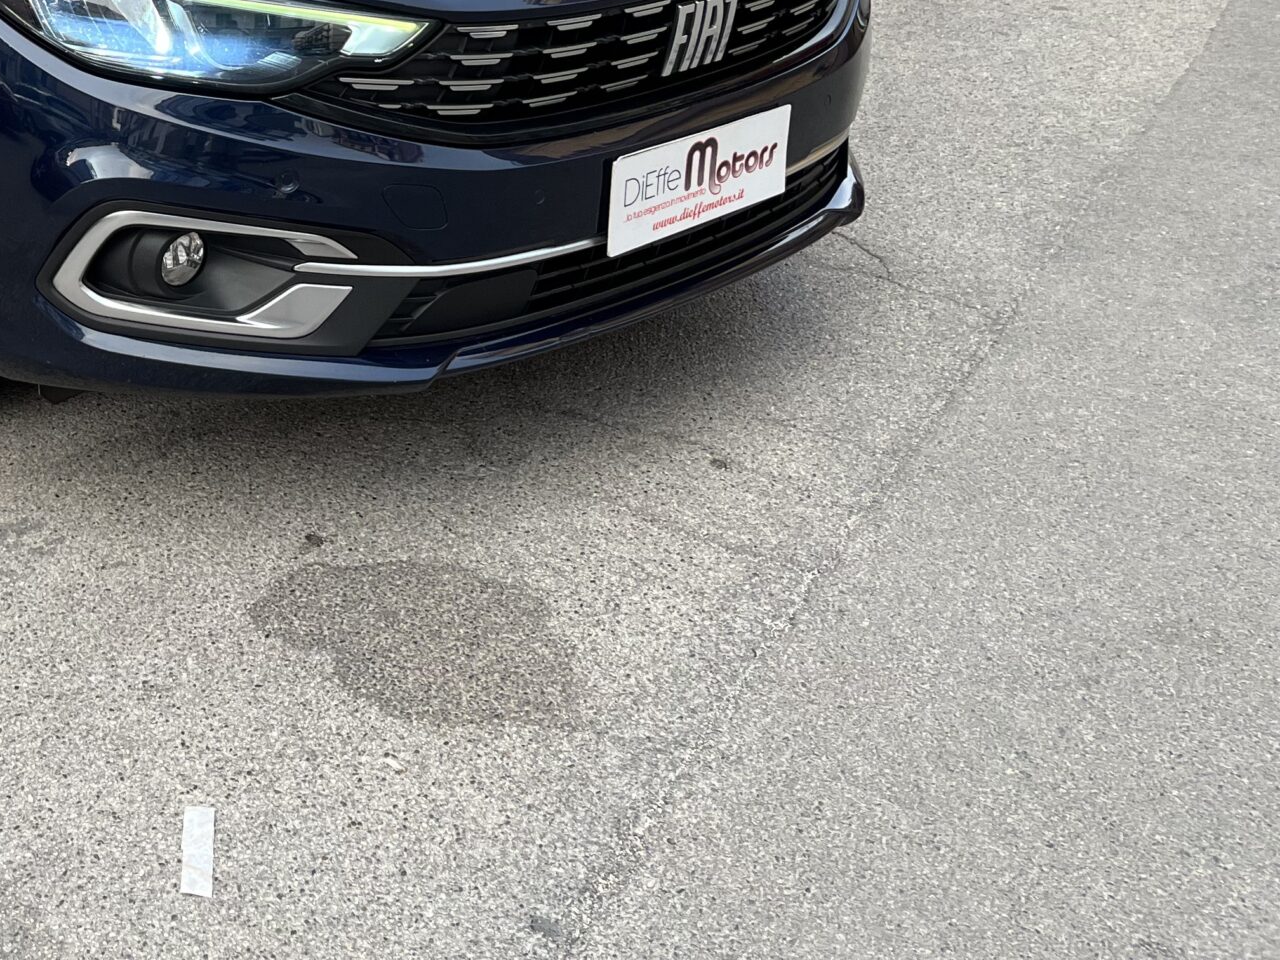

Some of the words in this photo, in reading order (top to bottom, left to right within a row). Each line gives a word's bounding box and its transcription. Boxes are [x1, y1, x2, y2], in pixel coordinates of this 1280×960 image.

[623, 165, 682, 208] DiEffe
[683, 136, 779, 196] Motors
[652, 187, 745, 231] www.dieffemotors.it
